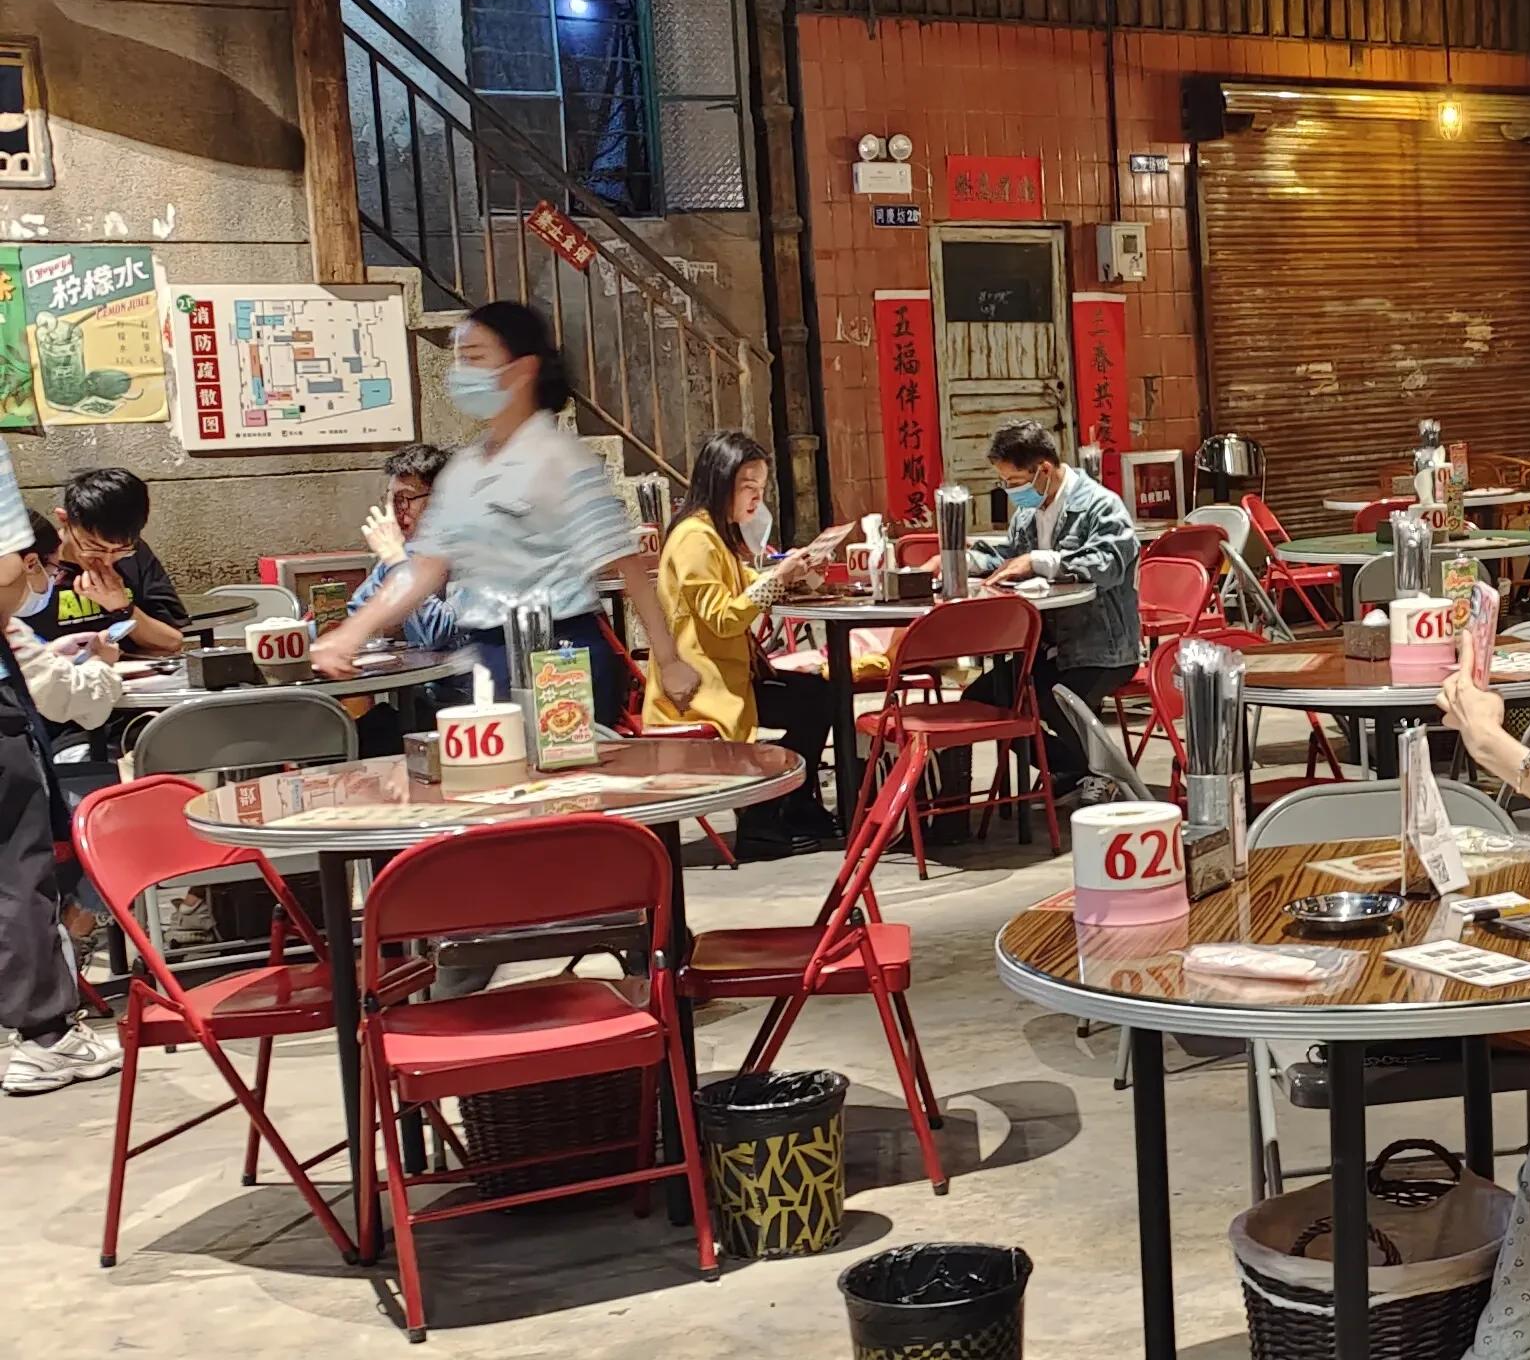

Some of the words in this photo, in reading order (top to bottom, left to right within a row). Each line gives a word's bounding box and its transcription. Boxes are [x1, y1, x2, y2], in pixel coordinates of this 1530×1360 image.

[49, 257, 149, 309] 柠檬水
[189, 306, 220, 433] 消防疏散图
[1415, 610, 1454, 639] 615
[257, 631, 305, 660] 610
[445, 721, 505, 759] 616
